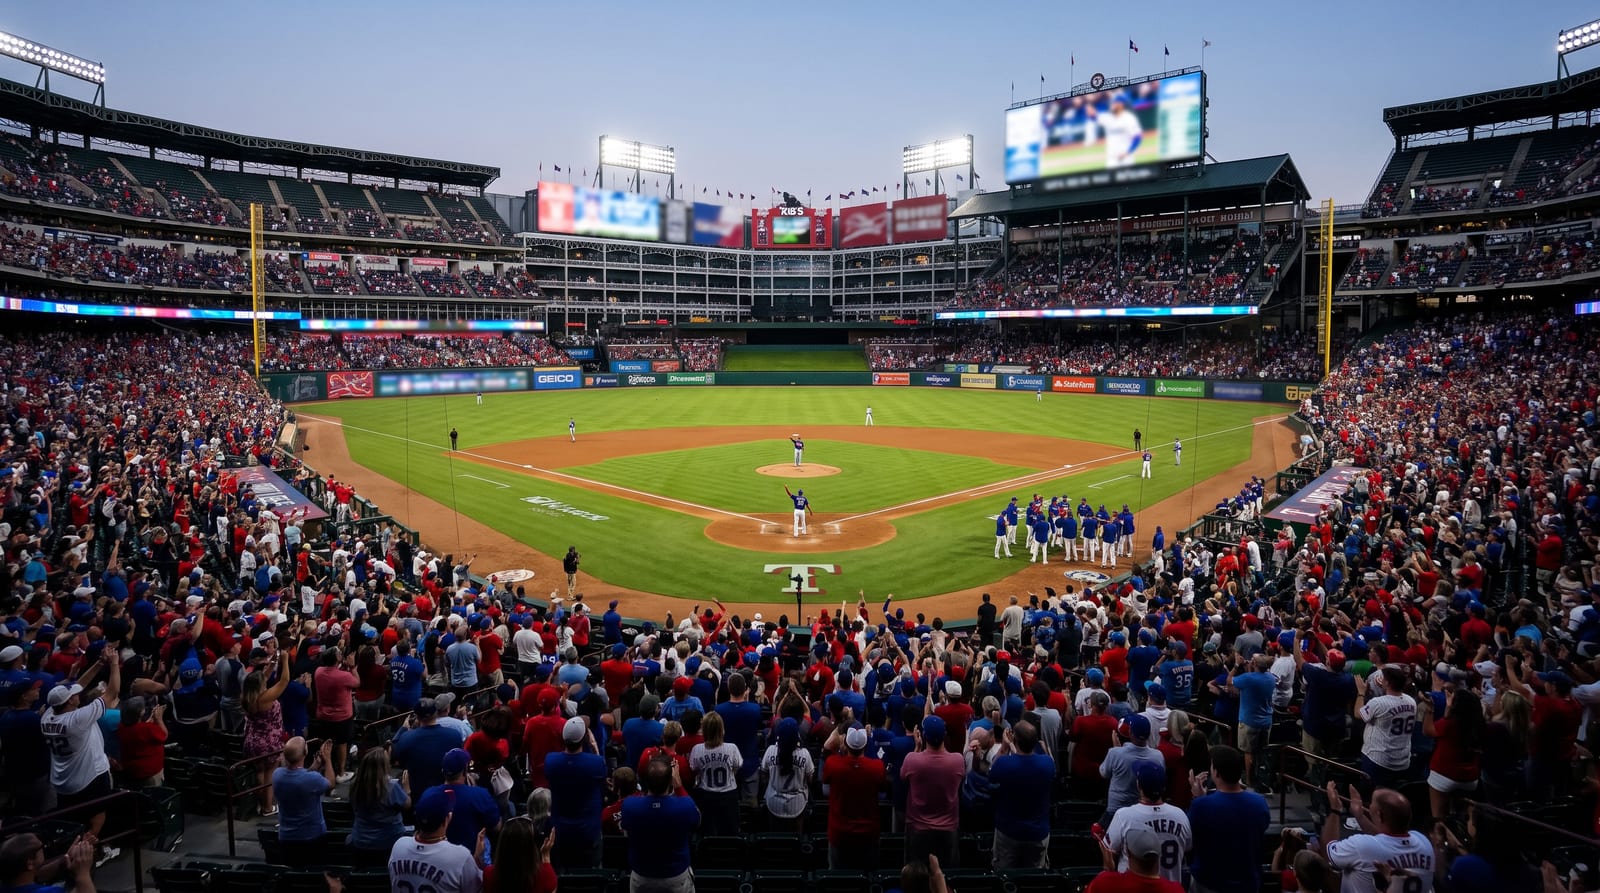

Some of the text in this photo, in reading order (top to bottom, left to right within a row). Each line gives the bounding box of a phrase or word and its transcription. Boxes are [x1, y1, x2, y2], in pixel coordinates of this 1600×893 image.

[538, 374, 574, 383] GEICO
[391, 669, 405, 683] 53
[1175, 674, 1192, 688] 35
[1391, 715, 1415, 735] 36
[706, 767, 727, 788] 10
